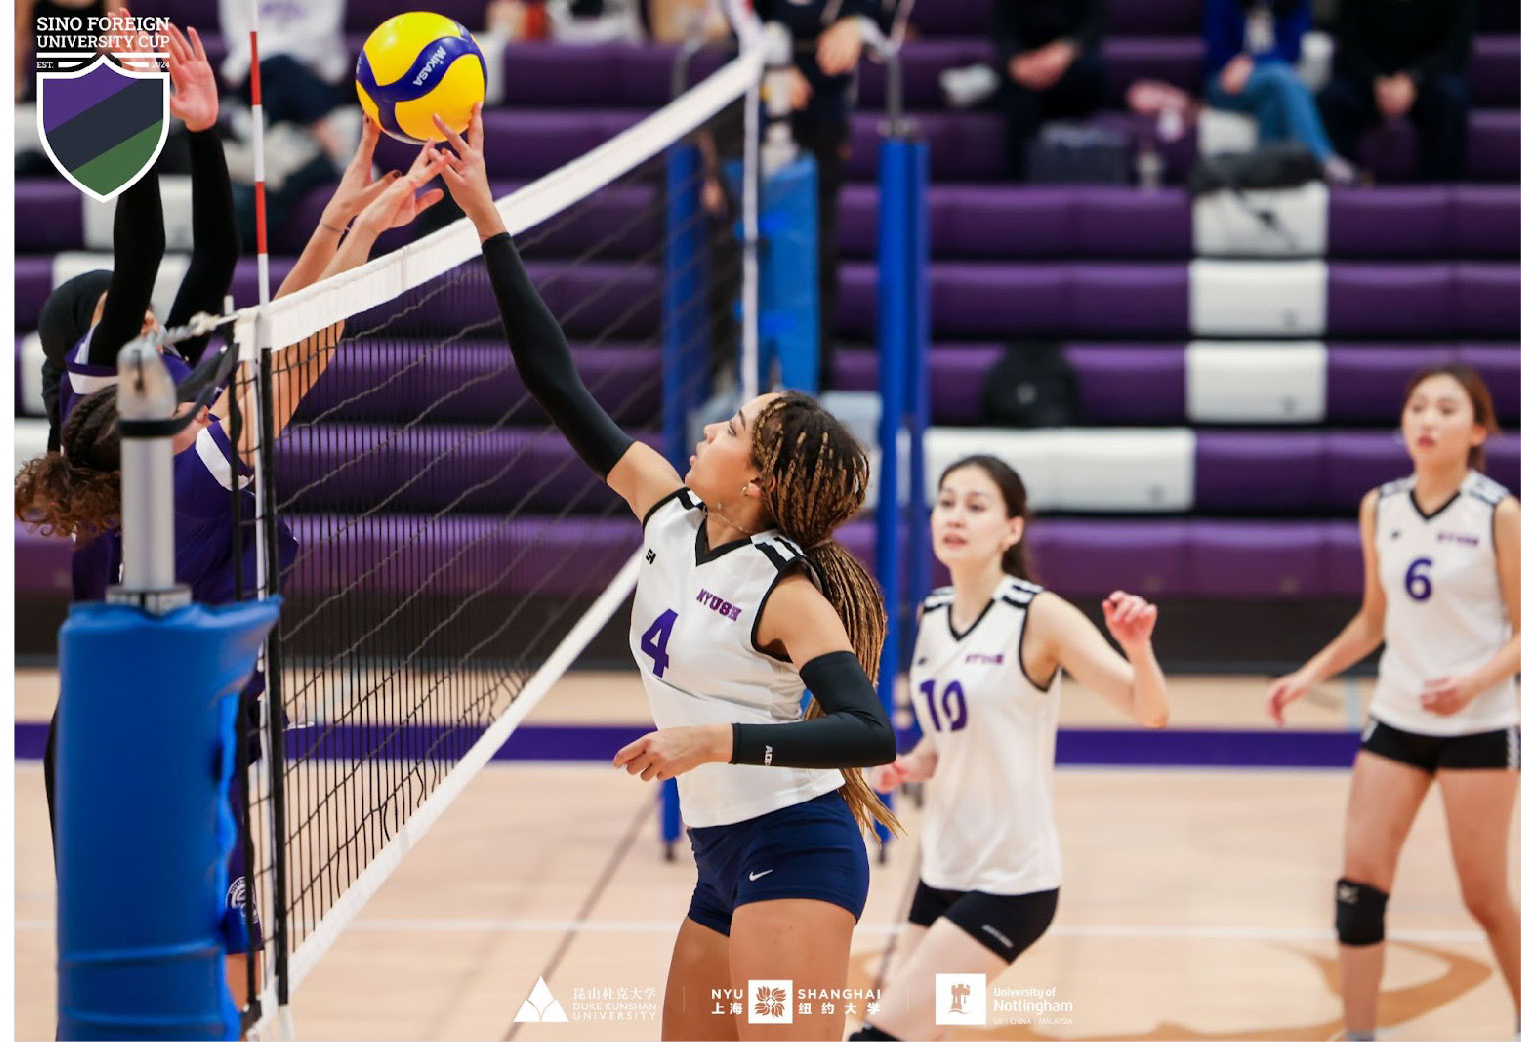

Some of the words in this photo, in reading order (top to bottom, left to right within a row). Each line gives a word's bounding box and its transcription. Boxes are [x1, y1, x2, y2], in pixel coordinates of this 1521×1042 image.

[1405, 556, 1433, 603] 6
[641, 608, 679, 679] 4
[919, 679, 968, 732] 10
